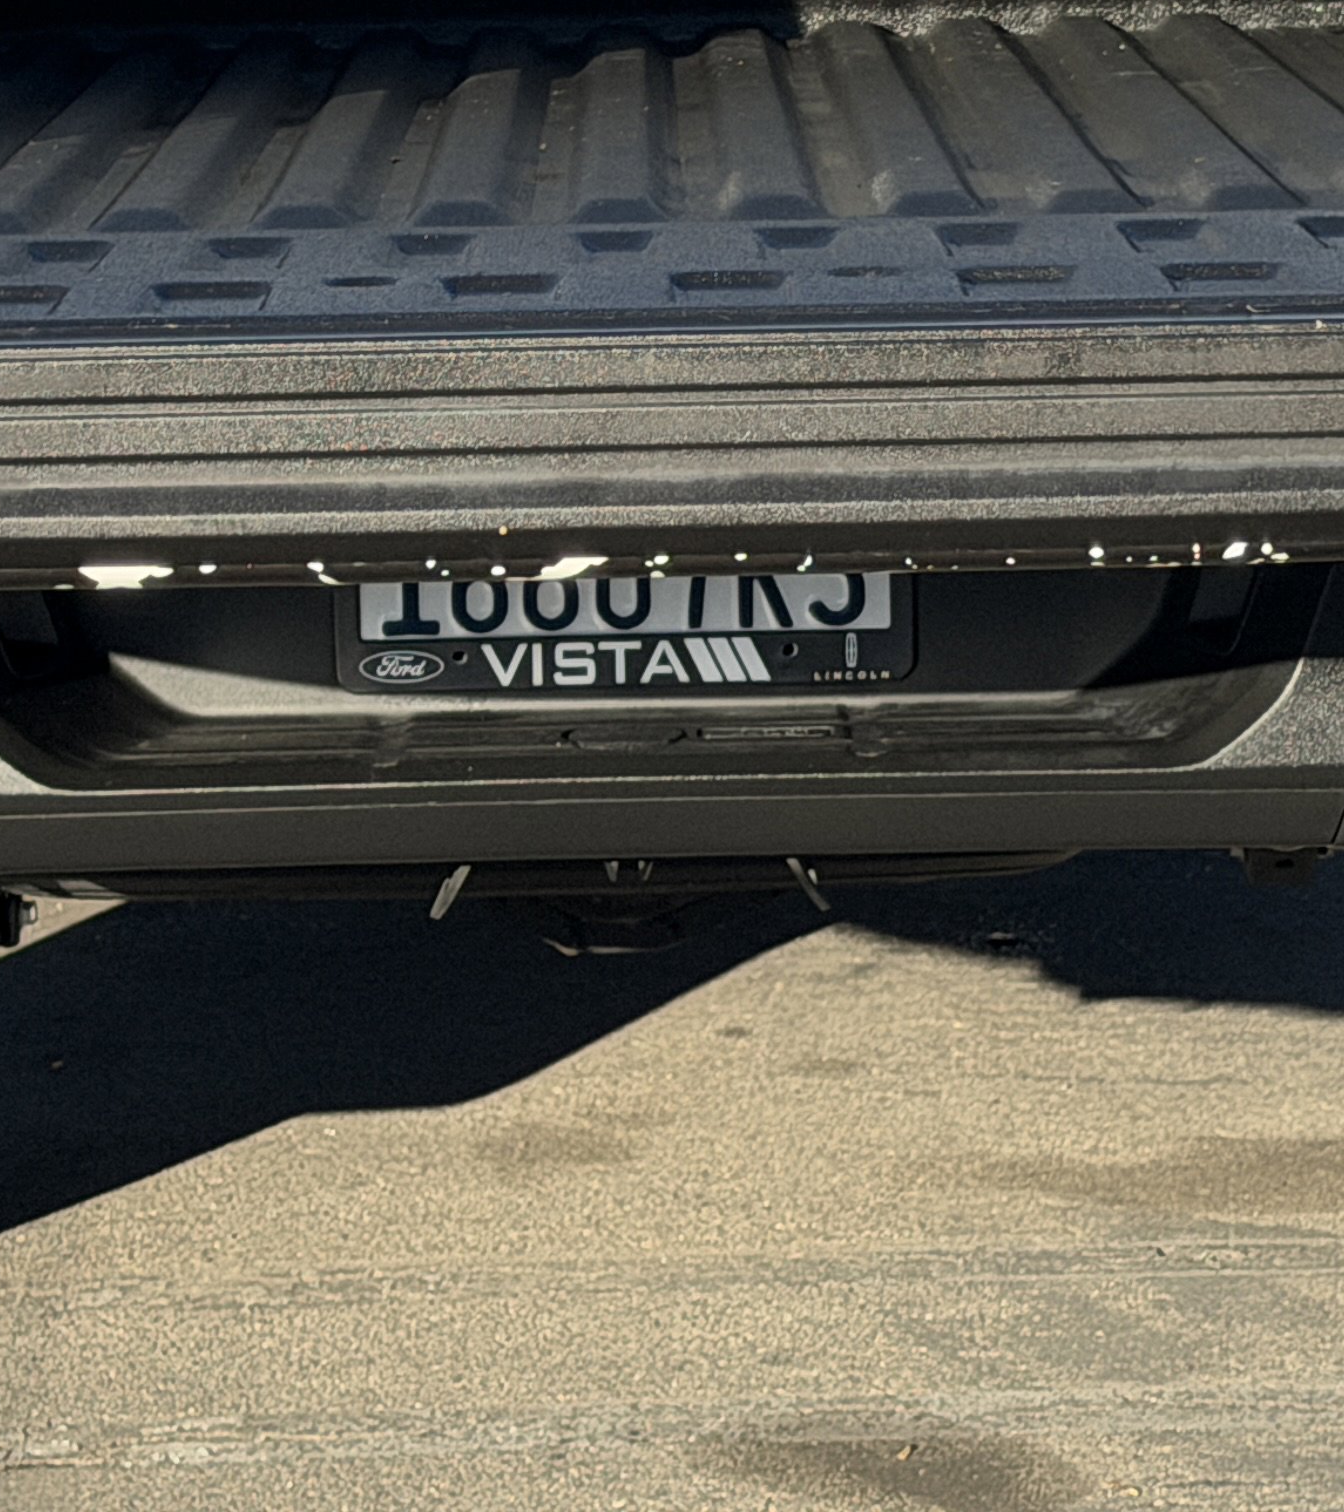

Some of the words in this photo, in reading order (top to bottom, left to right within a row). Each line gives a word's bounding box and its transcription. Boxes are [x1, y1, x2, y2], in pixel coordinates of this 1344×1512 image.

[376, 655, 427, 677] Ford
[480, 640, 690, 687] VISTA
[813, 670, 891, 682] LINCOLN
